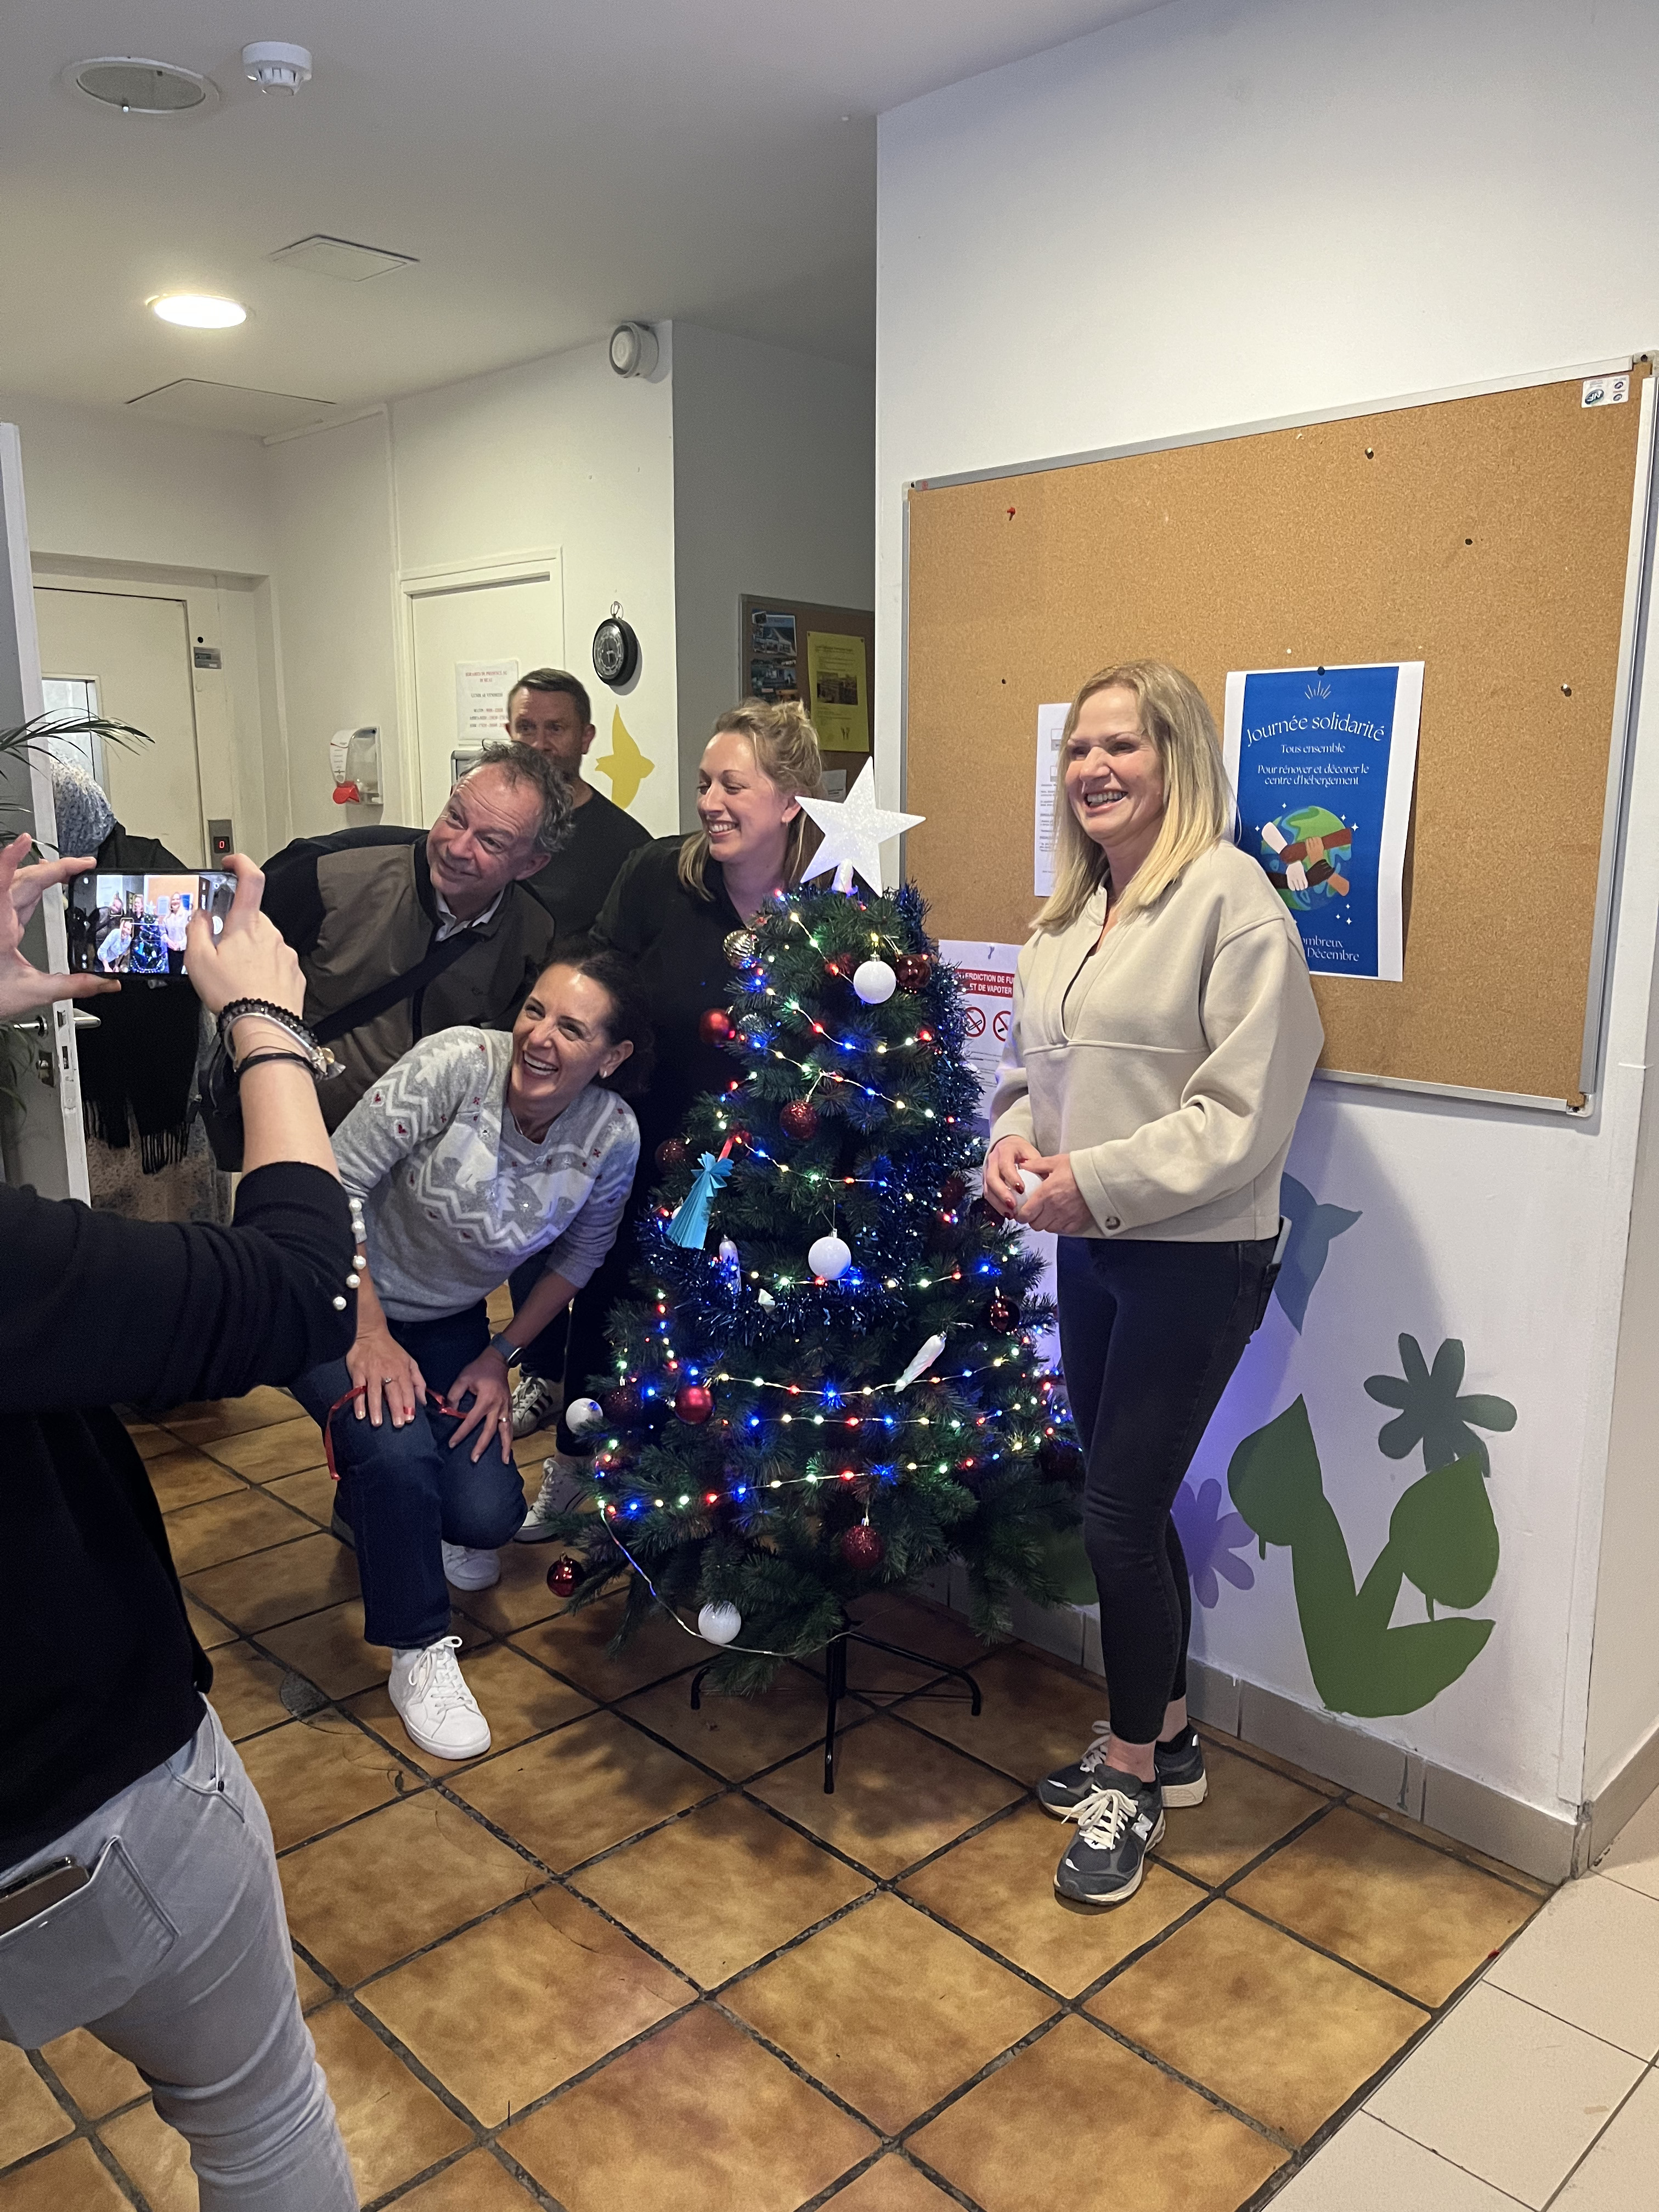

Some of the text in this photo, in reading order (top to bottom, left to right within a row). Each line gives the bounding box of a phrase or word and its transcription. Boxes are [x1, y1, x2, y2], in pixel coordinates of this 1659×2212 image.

[1246, 712, 1385, 747] Journée solidarité
[1280, 742, 1346, 754] Tous ensemble
[1257, 763, 1369, 774] Pour rénover et décorer le
[1265, 775, 1359, 788] centre d'hébergement
[219, 840, 225, 849] 0
[1307, 947, 1359, 962] Décembre
[978, 984, 986, 992] DE
[986, 985, 1012, 995] VAPOTER
